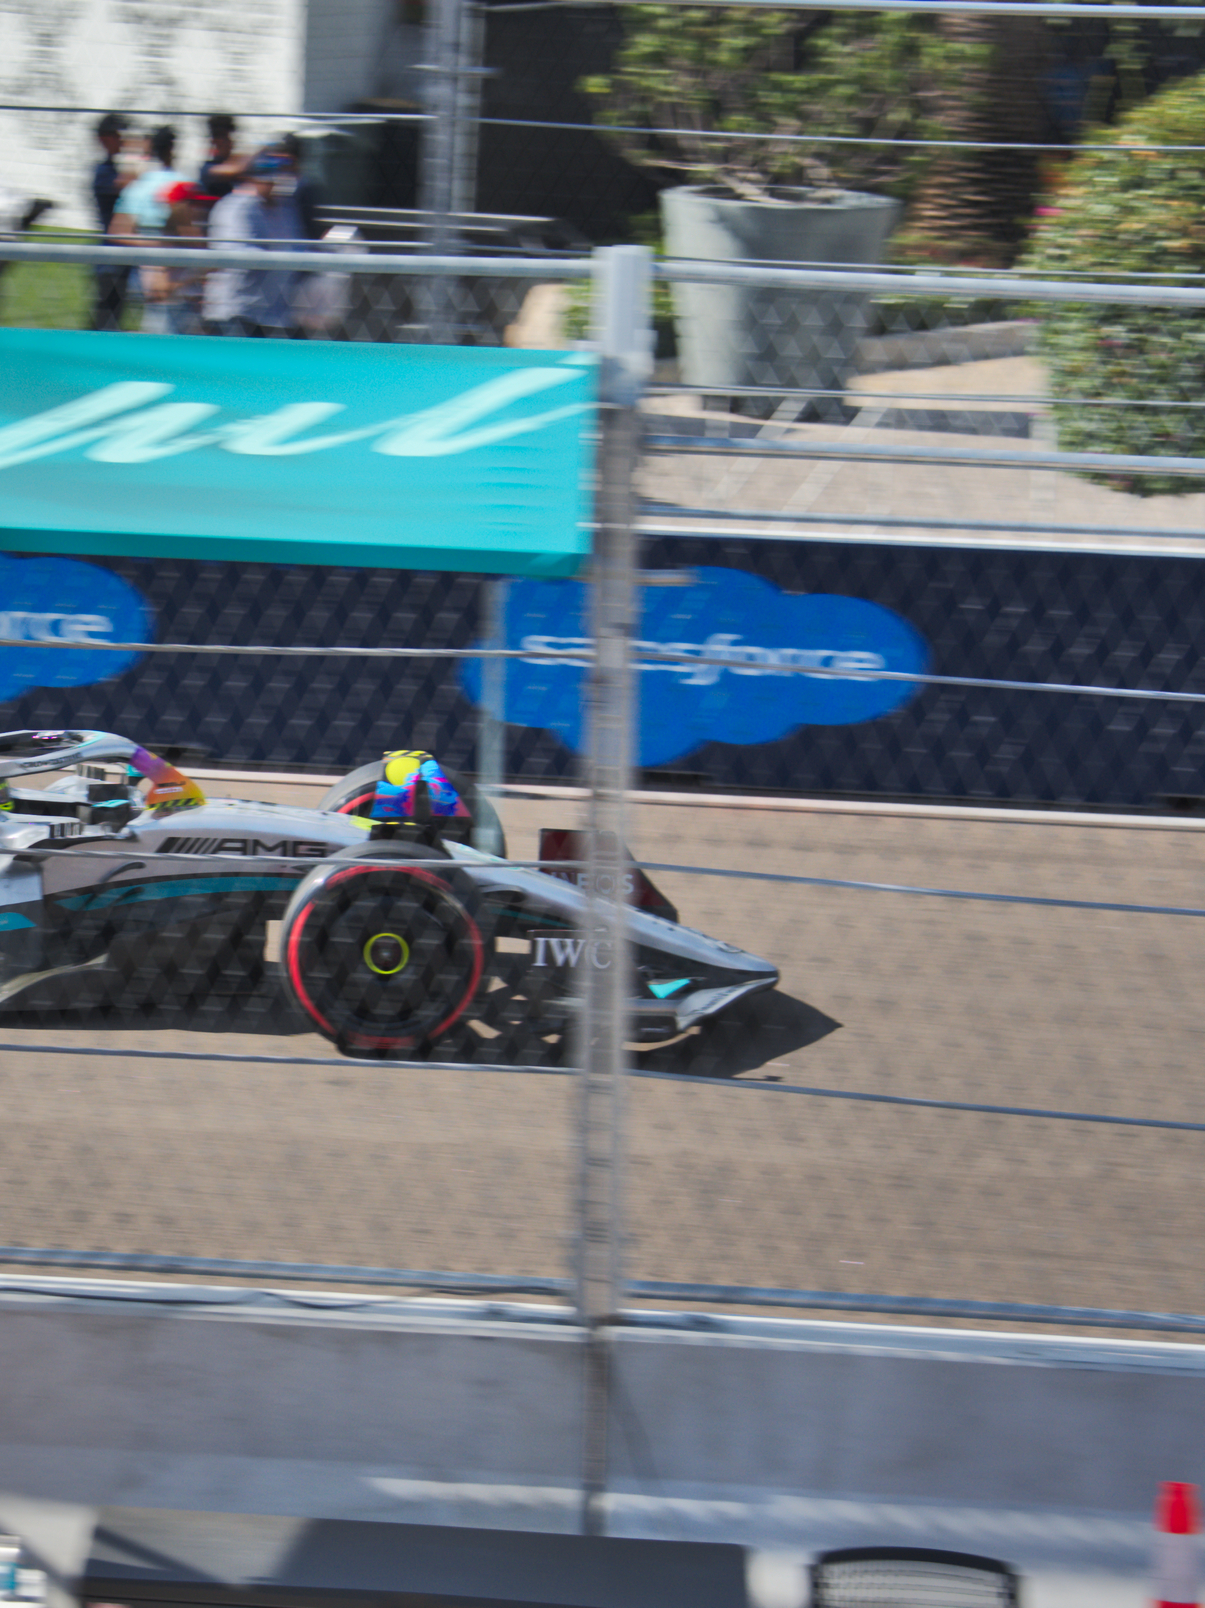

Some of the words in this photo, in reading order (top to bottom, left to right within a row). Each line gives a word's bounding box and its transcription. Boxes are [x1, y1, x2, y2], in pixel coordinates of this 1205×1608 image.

[519, 633, 888, 686] saesforce
[212, 837, 329, 858] AMG
[531, 937, 613, 970] IWC
